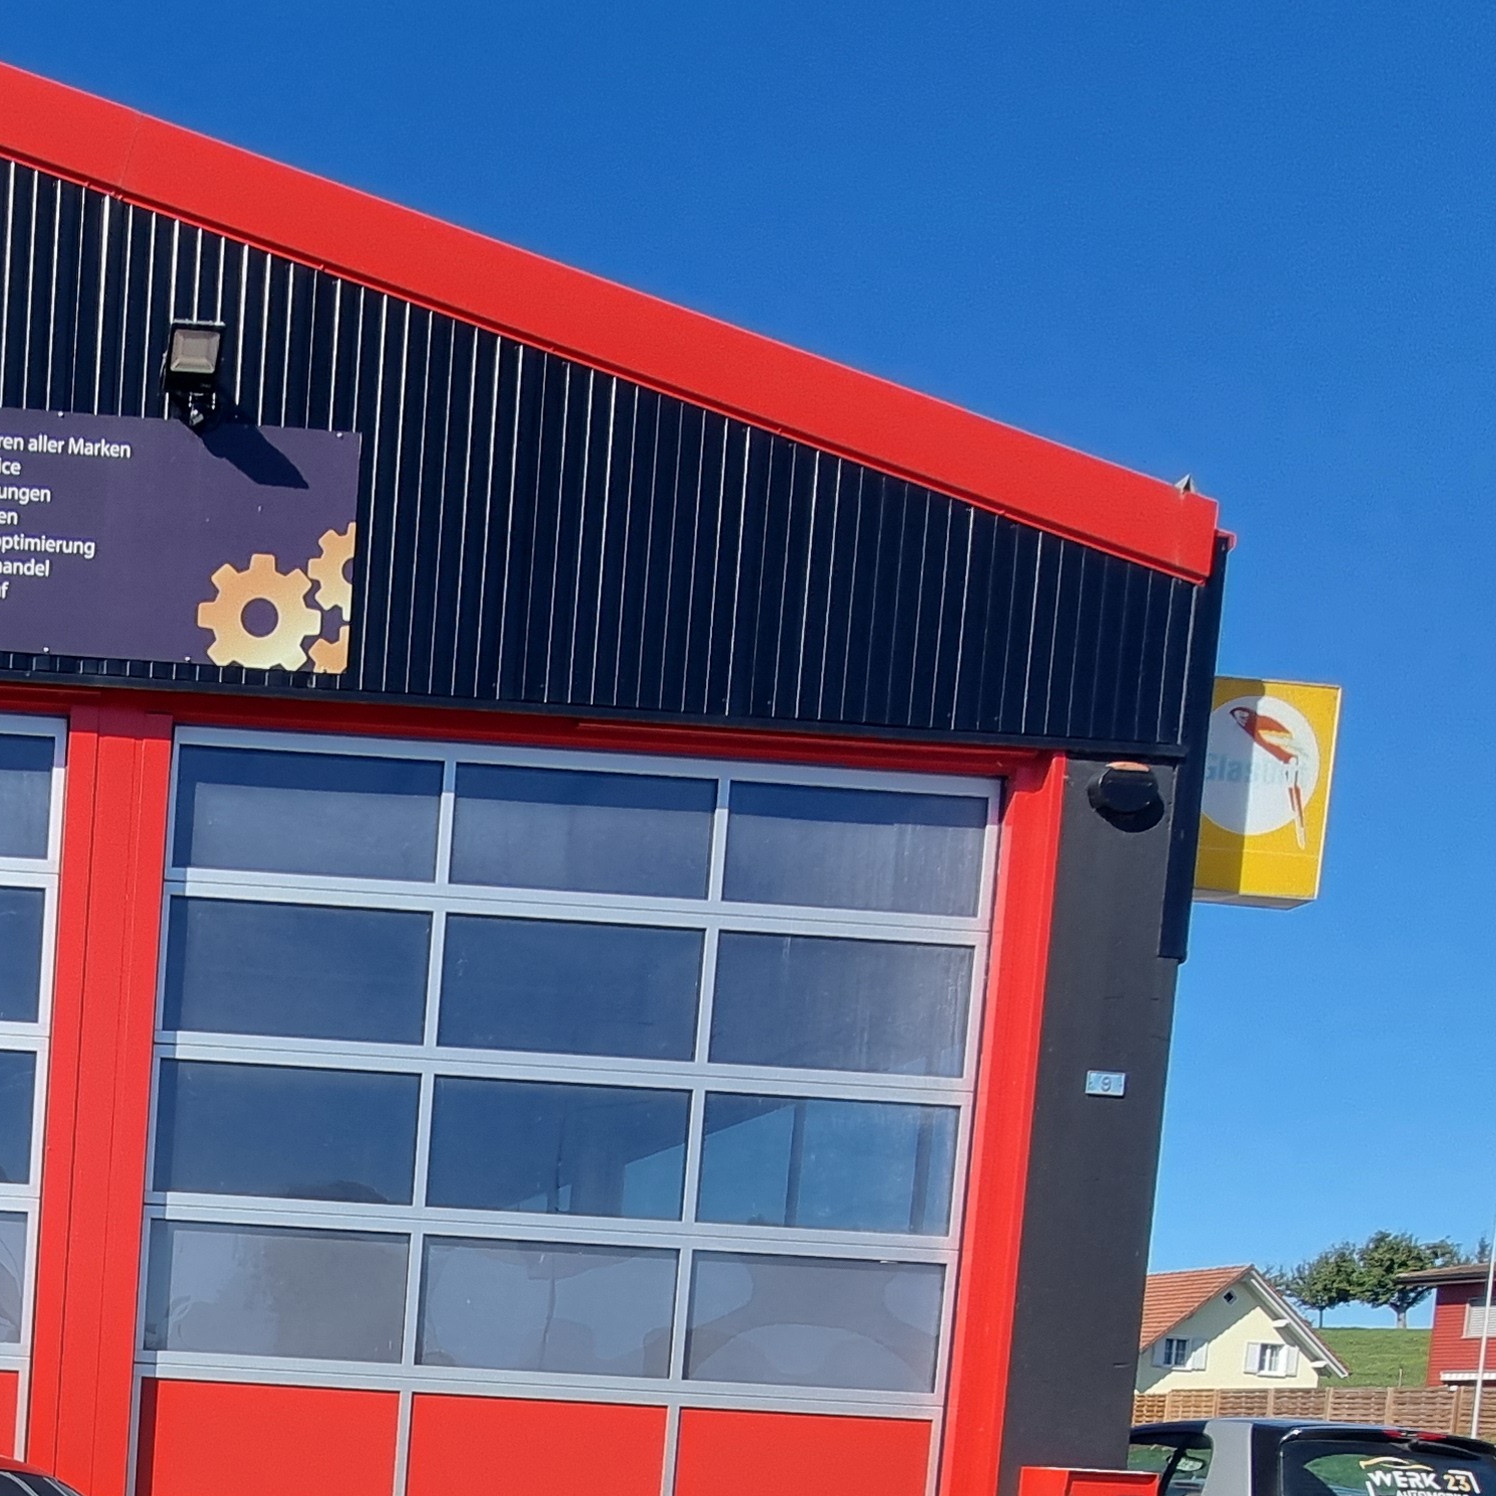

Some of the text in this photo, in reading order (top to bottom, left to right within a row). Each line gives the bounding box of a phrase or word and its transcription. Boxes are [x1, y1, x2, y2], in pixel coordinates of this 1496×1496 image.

[27, 434, 65, 454] aller
[67, 437, 132, 459] Marken
[1101, 1076, 1111, 1092] 9
[1367, 1470, 1471, 1492] WERK 23
